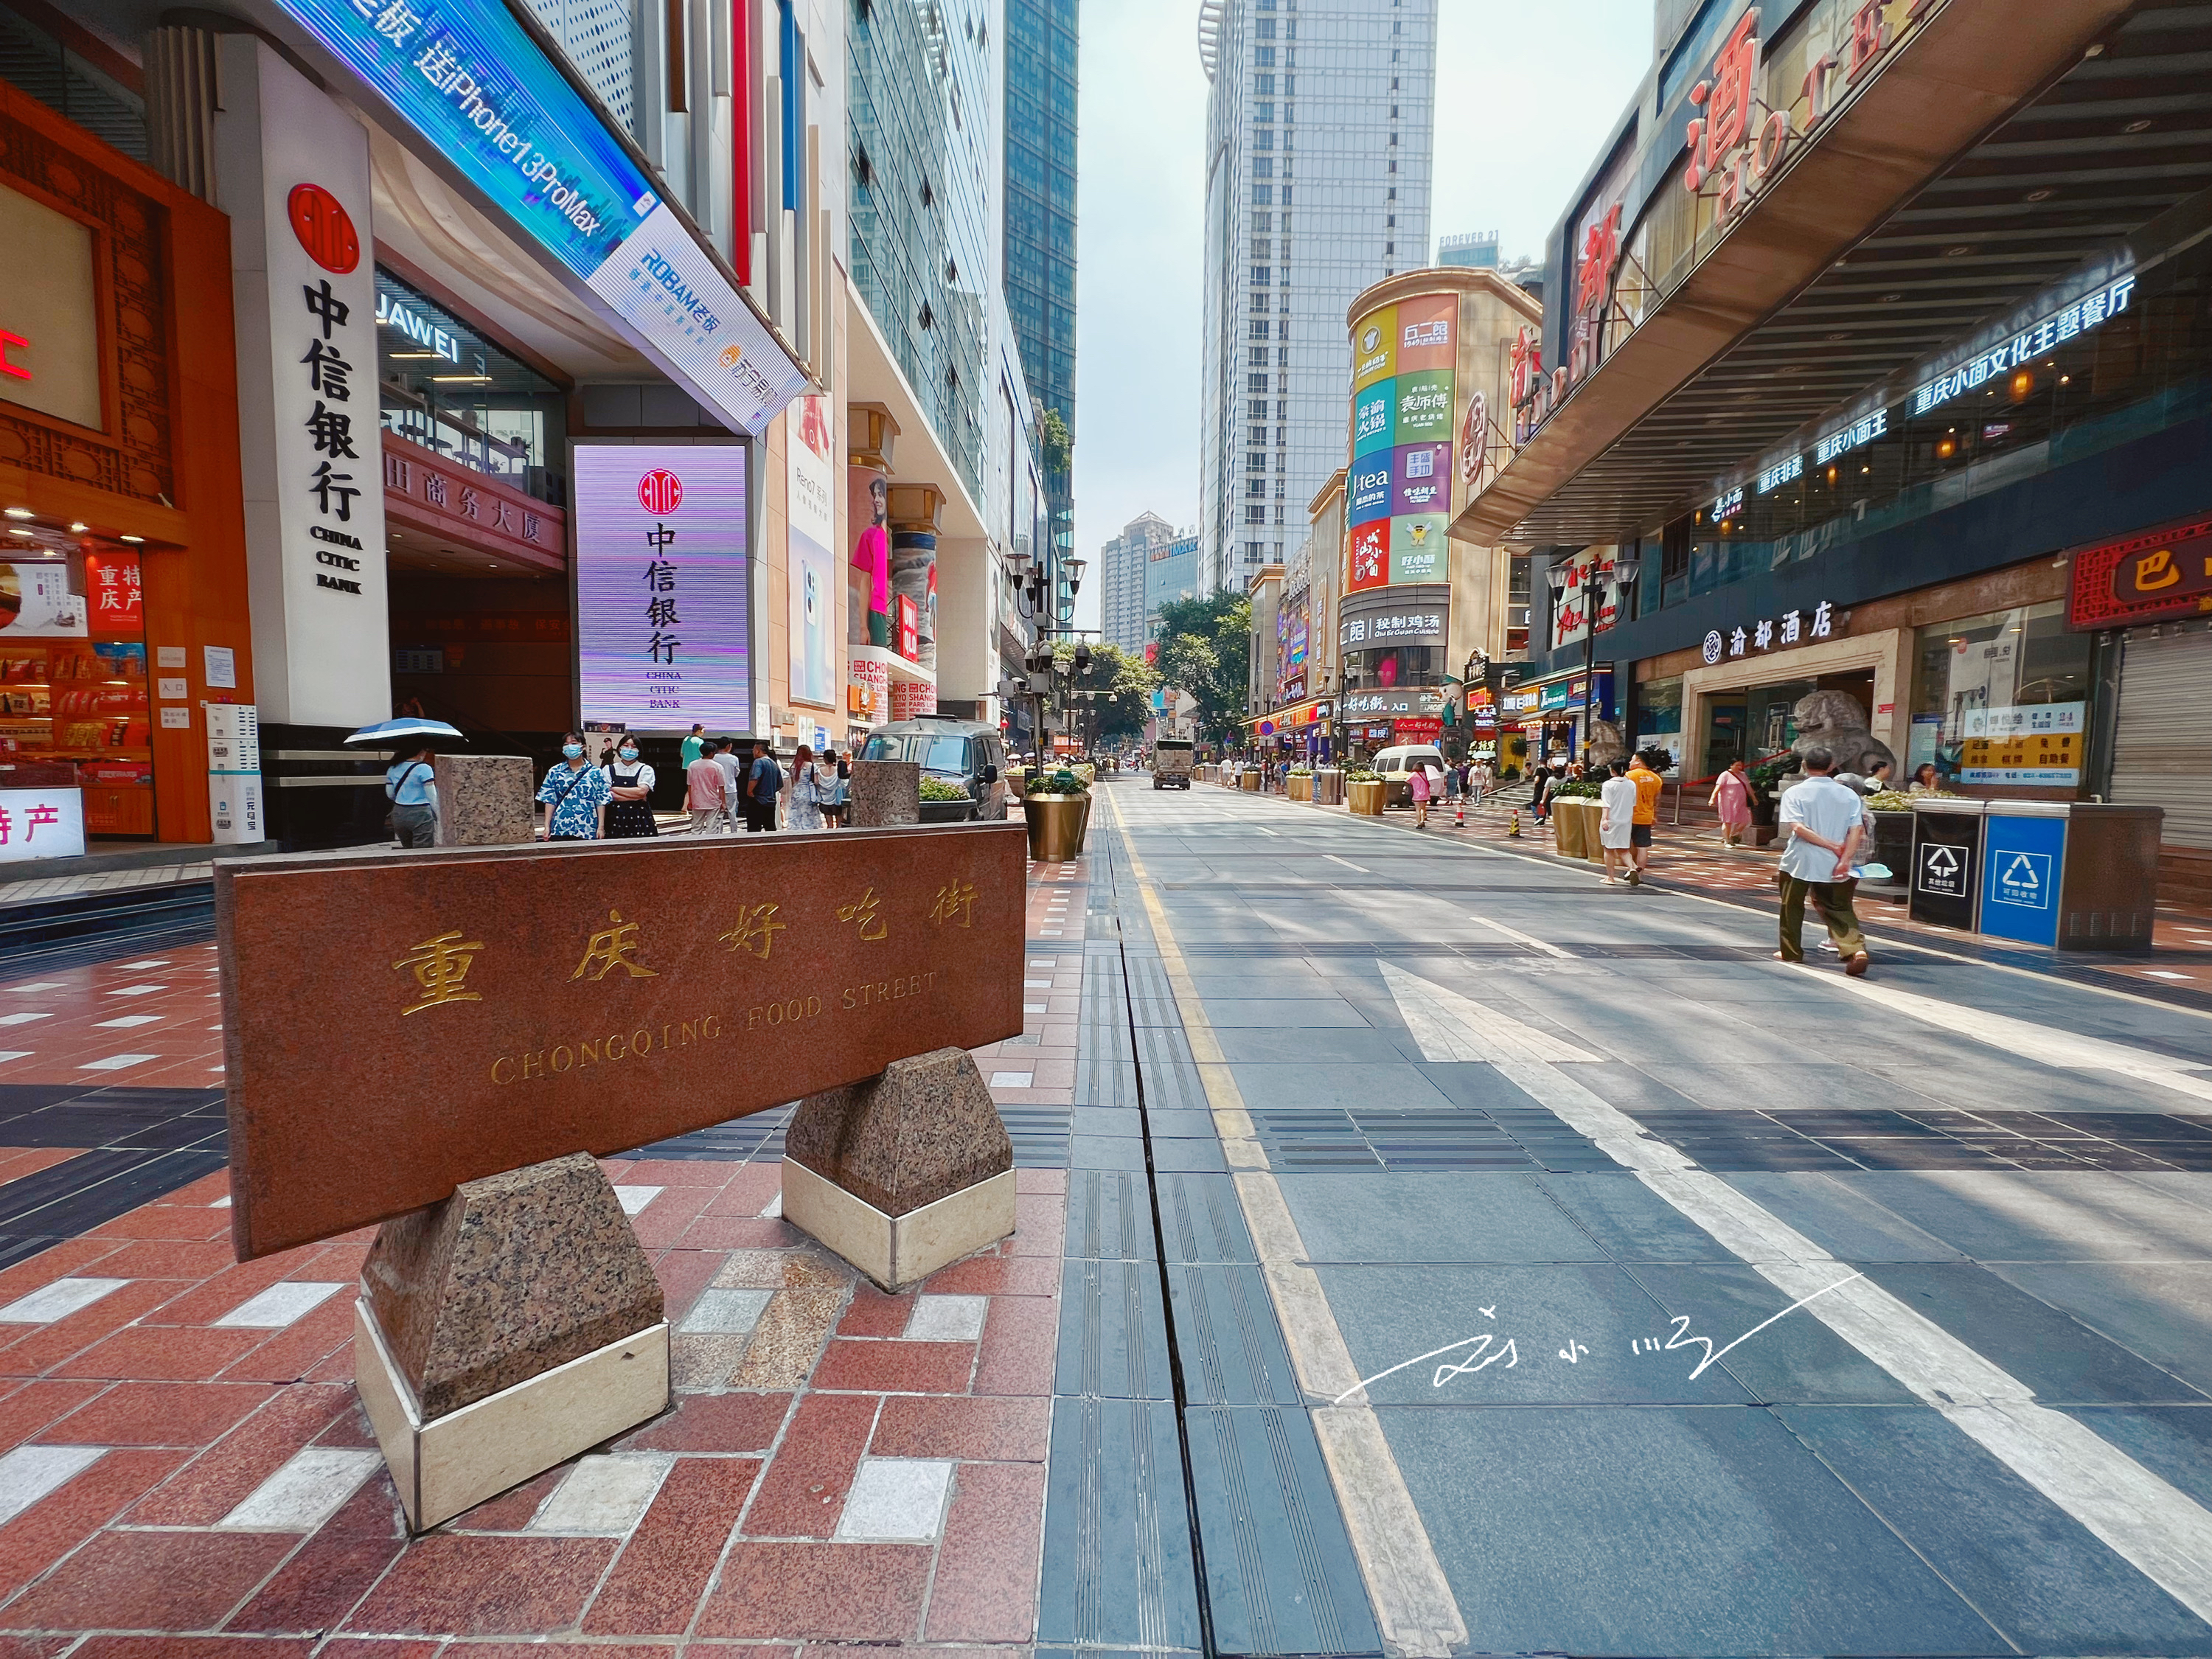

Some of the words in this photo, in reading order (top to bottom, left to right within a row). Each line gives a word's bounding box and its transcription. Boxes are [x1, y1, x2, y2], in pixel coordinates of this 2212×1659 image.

[1440, 232, 1483, 246] FOREVER
[1488, 229, 1498, 242] 21
[1915, 274, 2135, 415] 重庆小面文化主题餐厅
[299, 279, 361, 522] 中信银行
[1399, 393, 1448, 413] 袁师傅
[1357, 413, 1385, 437] 火锅
[1816, 408, 1888, 465] 重庆小面王
[796, 466, 815, 495] Reno7
[1759, 454, 1804, 494] 重庆非遗
[310, 526, 364, 550] CHINA
[316, 551, 360, 571] CITIC
[97, 565, 122, 610] 重庆
[122, 564, 142, 611] 特产
[316, 574, 363, 595] BANK
[643, 522, 681, 664] 中信银行
[903, 603, 916, 630] UNI
[1375, 614, 1440, 630] 秘制鸡汤
[1730, 600, 1832, 656] 渝都酒店
[904, 630, 917, 655] QLO
[159, 683, 184, 692] 入口
[646, 672, 682, 680] CHINA
[650, 686, 679, 694] CITIC
[649, 700, 681, 709] BANK
[1335, 695, 1384, 712] 八一好吃街
[1391, 702, 1408, 712] 入口
[1470, 740, 1497, 752] 巴将军
[1928, 877, 1955, 888] 其他垃圾
[2003, 888, 2038, 900] 可回收物
[392, 878, 978, 1016] 重庆好吃街
[491, 1015, 721, 1085] CHONGQING
[746, 995, 822, 1032] FOOD
[842, 971, 937, 1009] STREET
